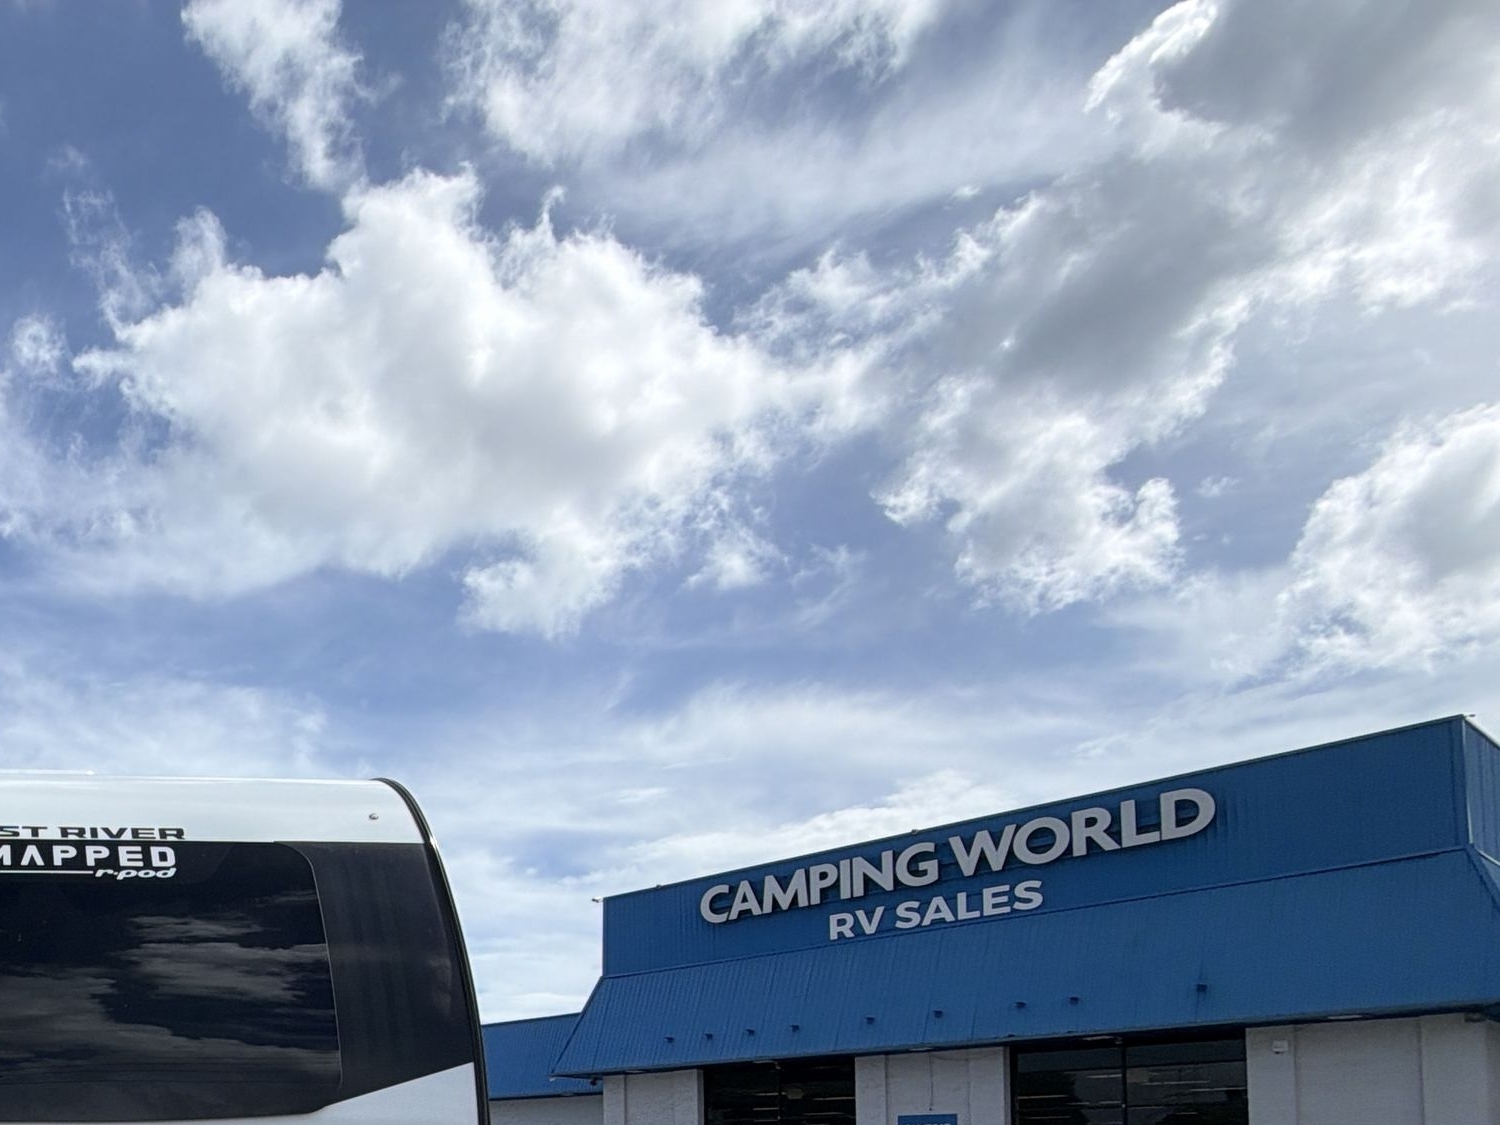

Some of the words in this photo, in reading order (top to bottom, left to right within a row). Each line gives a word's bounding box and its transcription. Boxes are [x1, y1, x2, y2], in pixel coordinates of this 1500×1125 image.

[58, 826, 186, 840] RIVER
[700, 842, 939, 924] CAMPING
[948, 788, 1217, 877] WORLD
[829, 906, 885, 940] RV
[895, 879, 1044, 929] SALES
